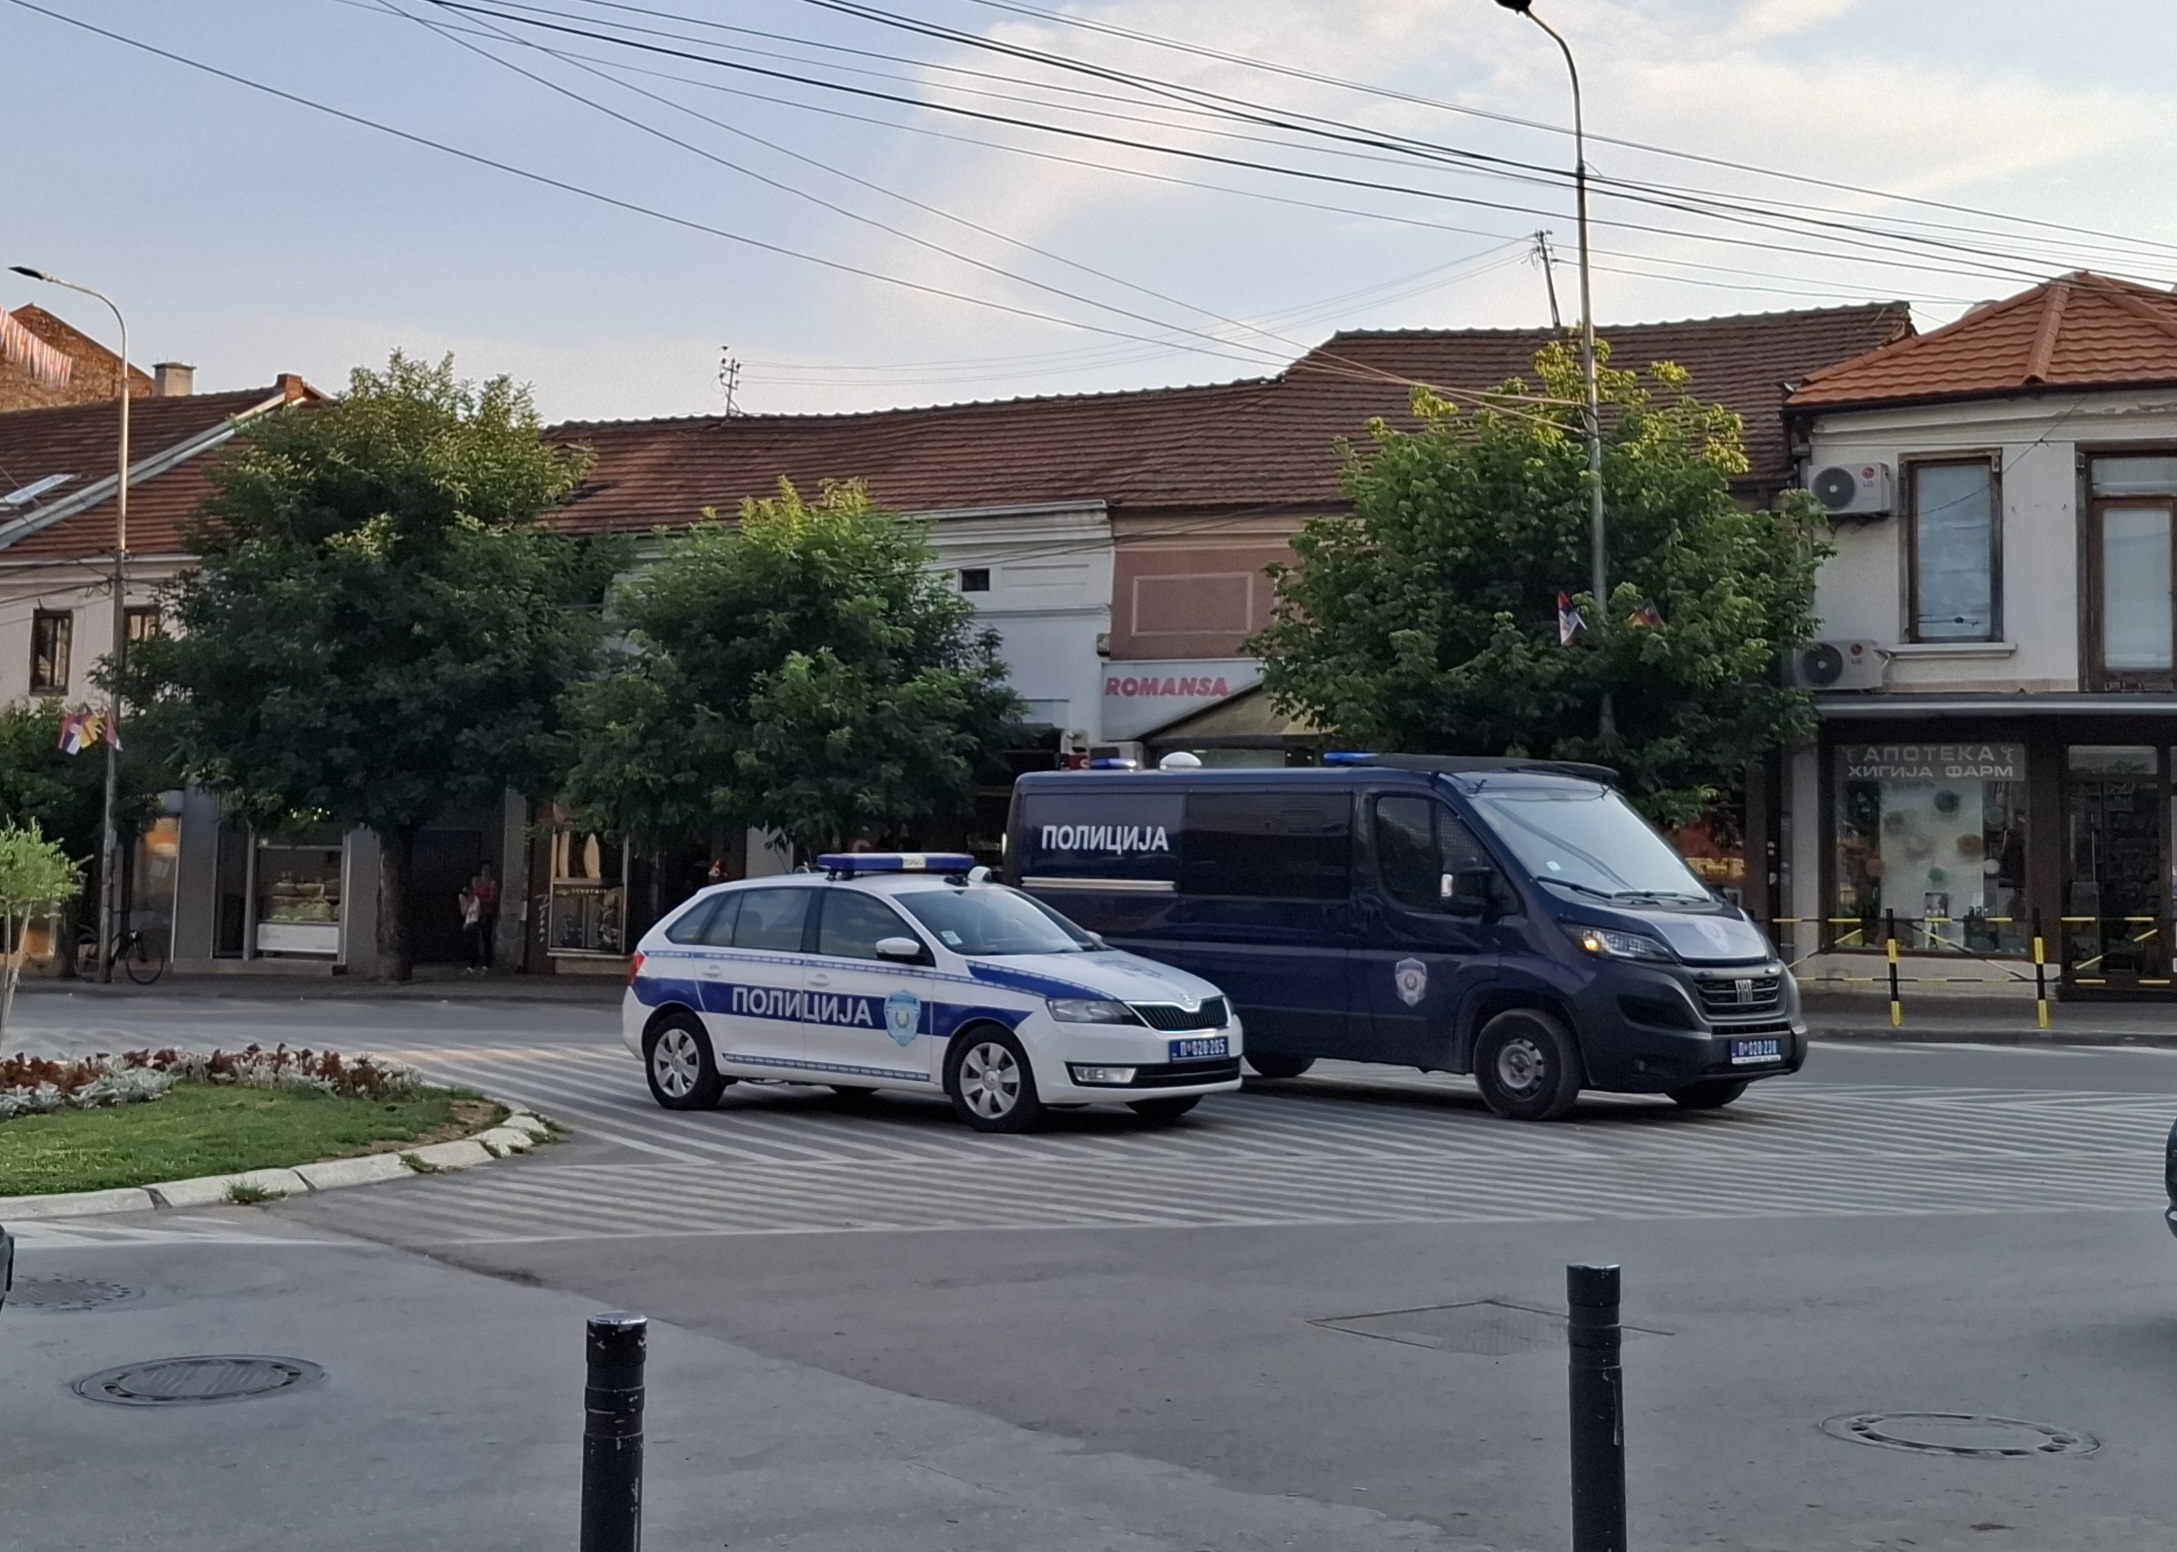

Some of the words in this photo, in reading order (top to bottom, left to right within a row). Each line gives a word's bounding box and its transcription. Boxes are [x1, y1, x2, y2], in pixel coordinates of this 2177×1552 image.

[1104, 676, 1229, 697] ROMANSA
[1863, 746, 1995, 762] АПОТЕКА
[1848, 765, 1934, 778] ХИГИЈА
[1945, 765, 2013, 778] ФАРМ
[1041, 825, 1169, 855] ПОЛИЦИЈА
[732, 986, 873, 1027] ПОЛИЦИЈА
